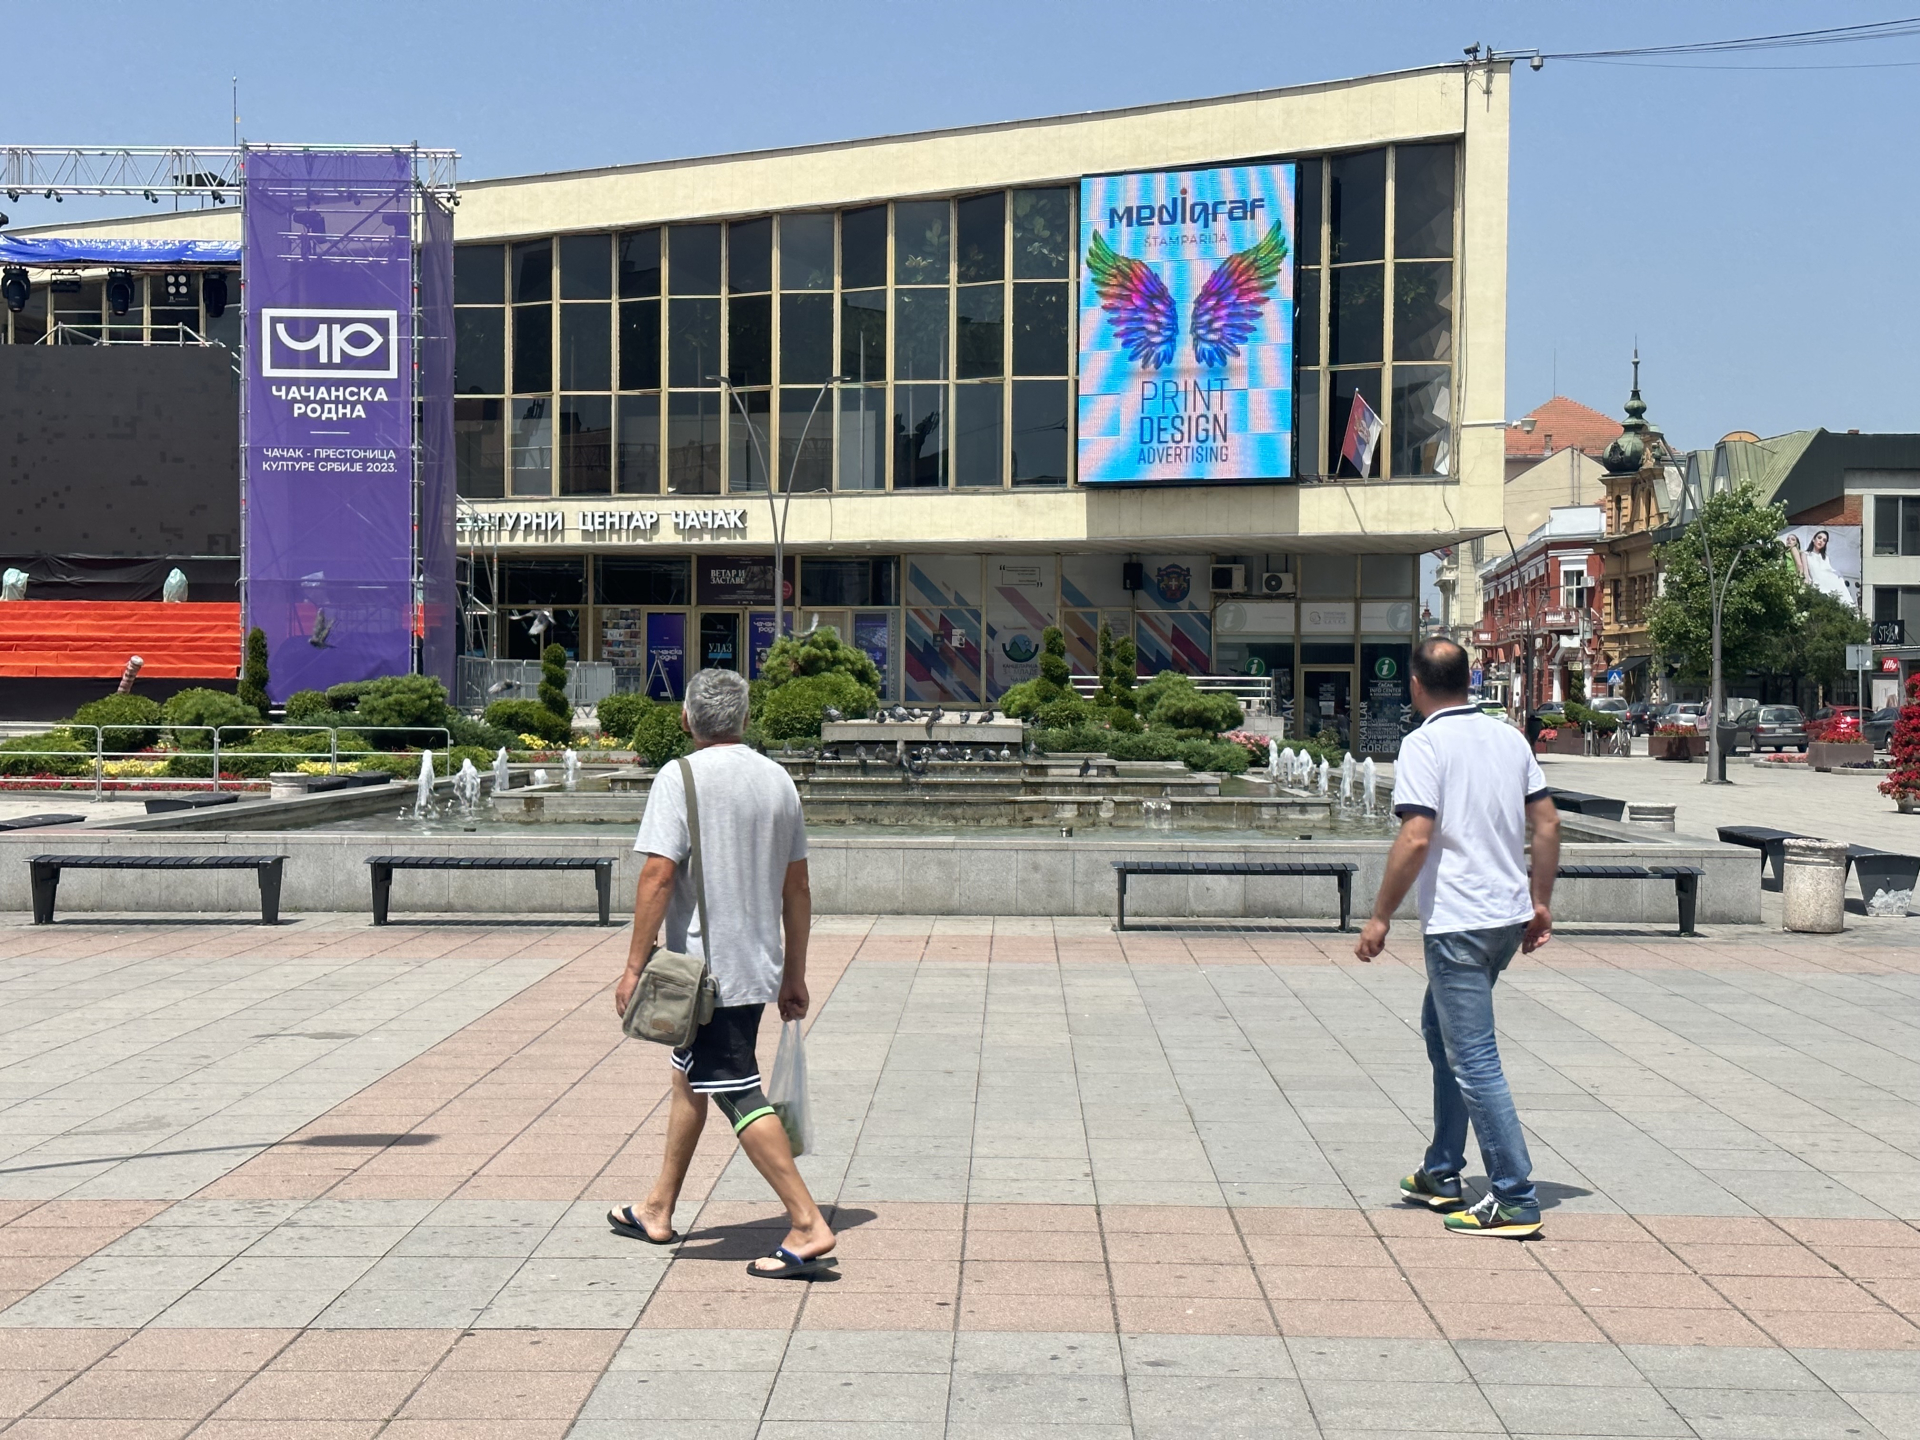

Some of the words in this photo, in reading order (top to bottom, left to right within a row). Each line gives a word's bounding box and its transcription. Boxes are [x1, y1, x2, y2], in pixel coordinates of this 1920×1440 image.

[271, 385, 388, 402] ЧАЧАНСКА
[1141, 377, 1229, 414] PRINT
[293, 403, 366, 421] РОДНА
[1140, 414, 1228, 445] DESIGN
[263, 448, 303, 459] ЧАЧАК
[314, 448, 396, 461] ПРЕСТОНИЦА
[1137, 445, 1229, 464] ADVERTISING
[262, 461, 315, 472] КУЛТУРЕ
[318, 462, 363, 472] СРБИЈЕ
[366, 462, 398, 473] 2023.
[578, 510, 659, 532] ЦЕНТАР
[670, 509, 746, 531] ЧАЧАК
[710, 569, 737, 578] ВЕТАР
[738, 569, 745, 577] И
[708, 642, 732, 653] УЛАЗ
[1883, 659, 1897, 670] illy
[1359, 701, 1368, 740] KABLAR
[1360, 744, 1396, 753] GORGE
